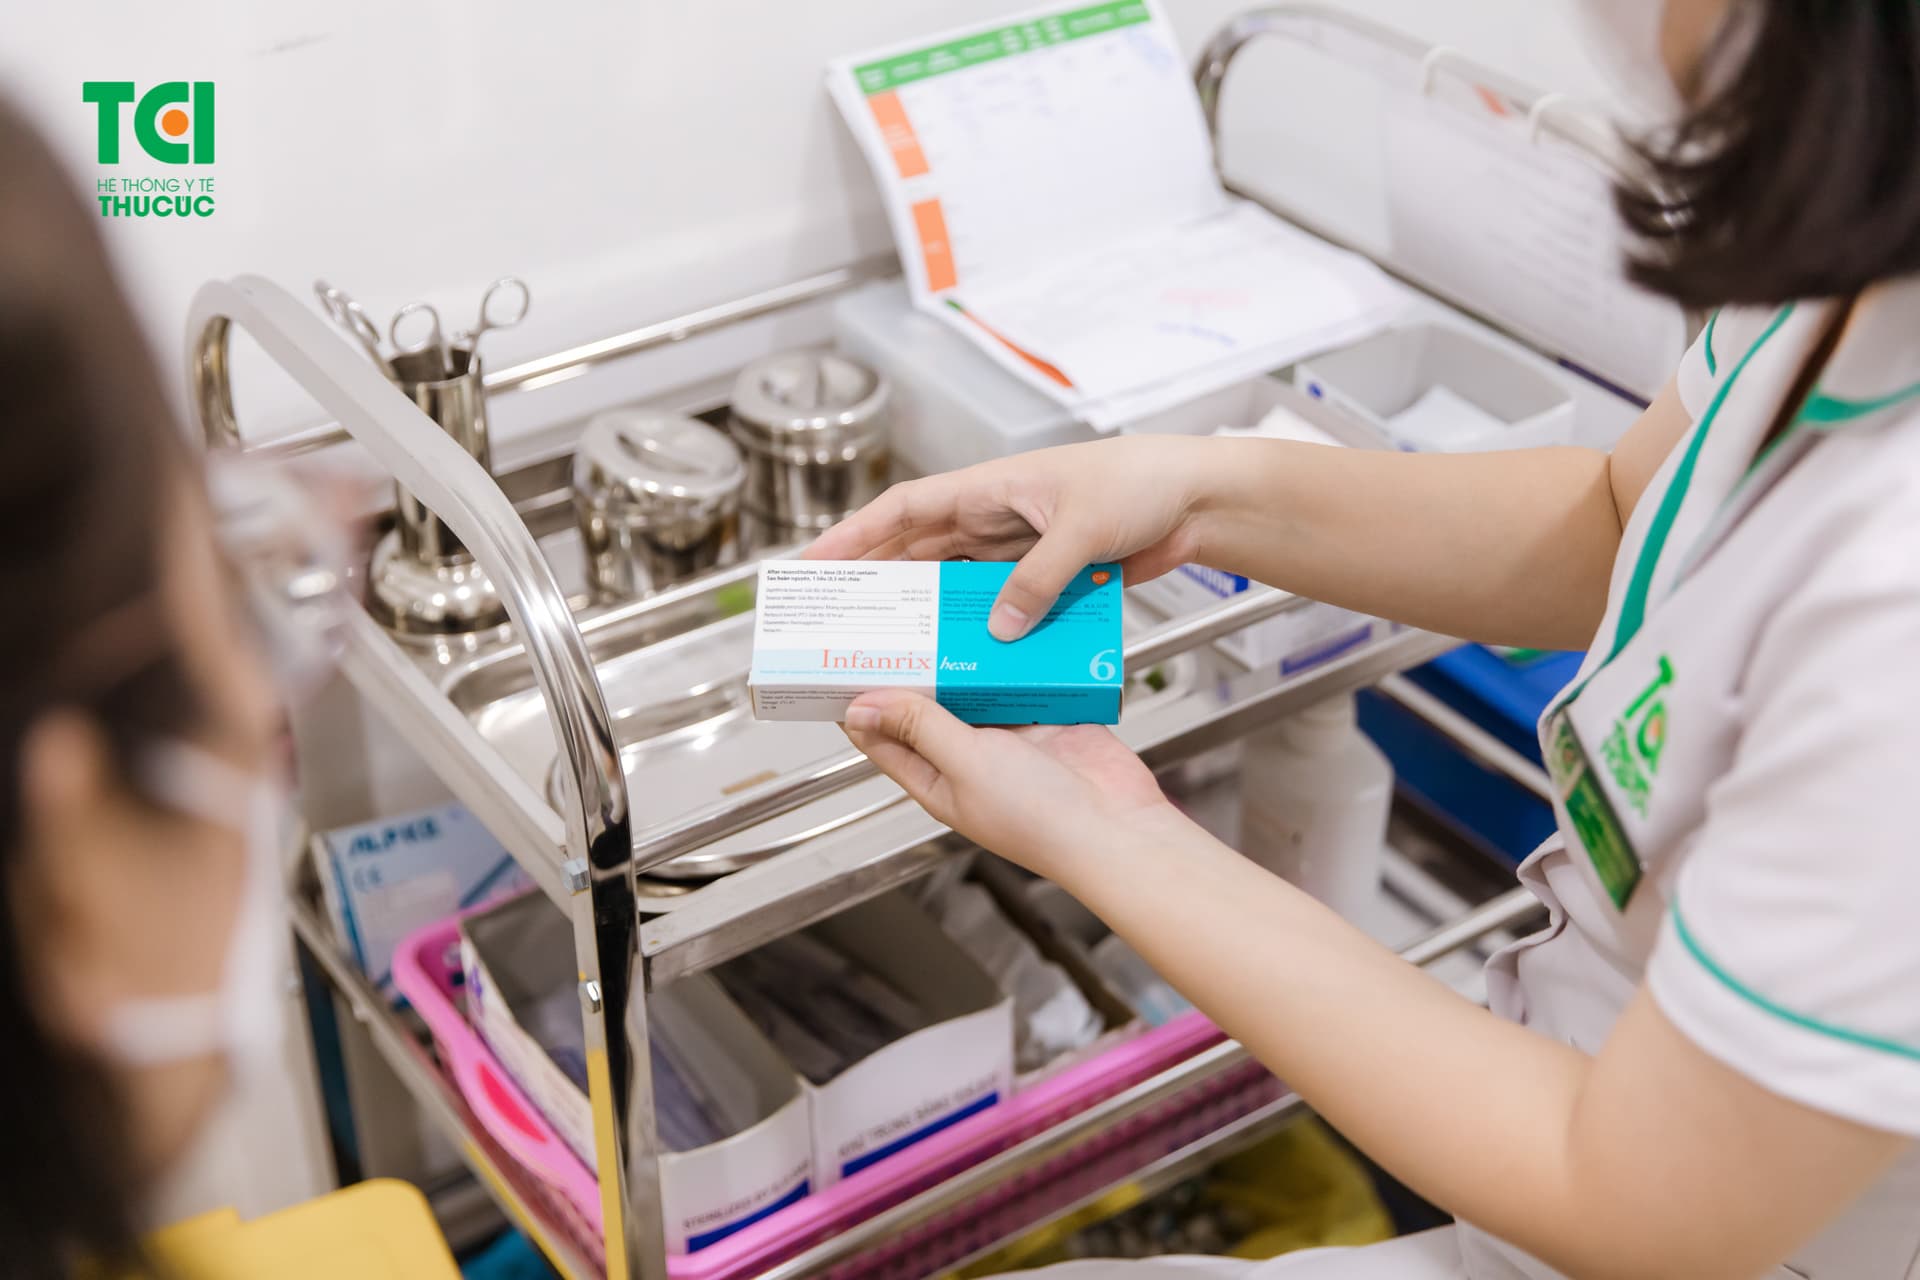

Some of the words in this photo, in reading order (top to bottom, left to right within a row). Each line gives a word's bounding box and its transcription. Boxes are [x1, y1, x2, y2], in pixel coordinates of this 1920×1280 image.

[822, 648, 931, 670] Infanrix
[939, 656, 977, 671] hexa
[1089, 649, 1117, 681] 6
